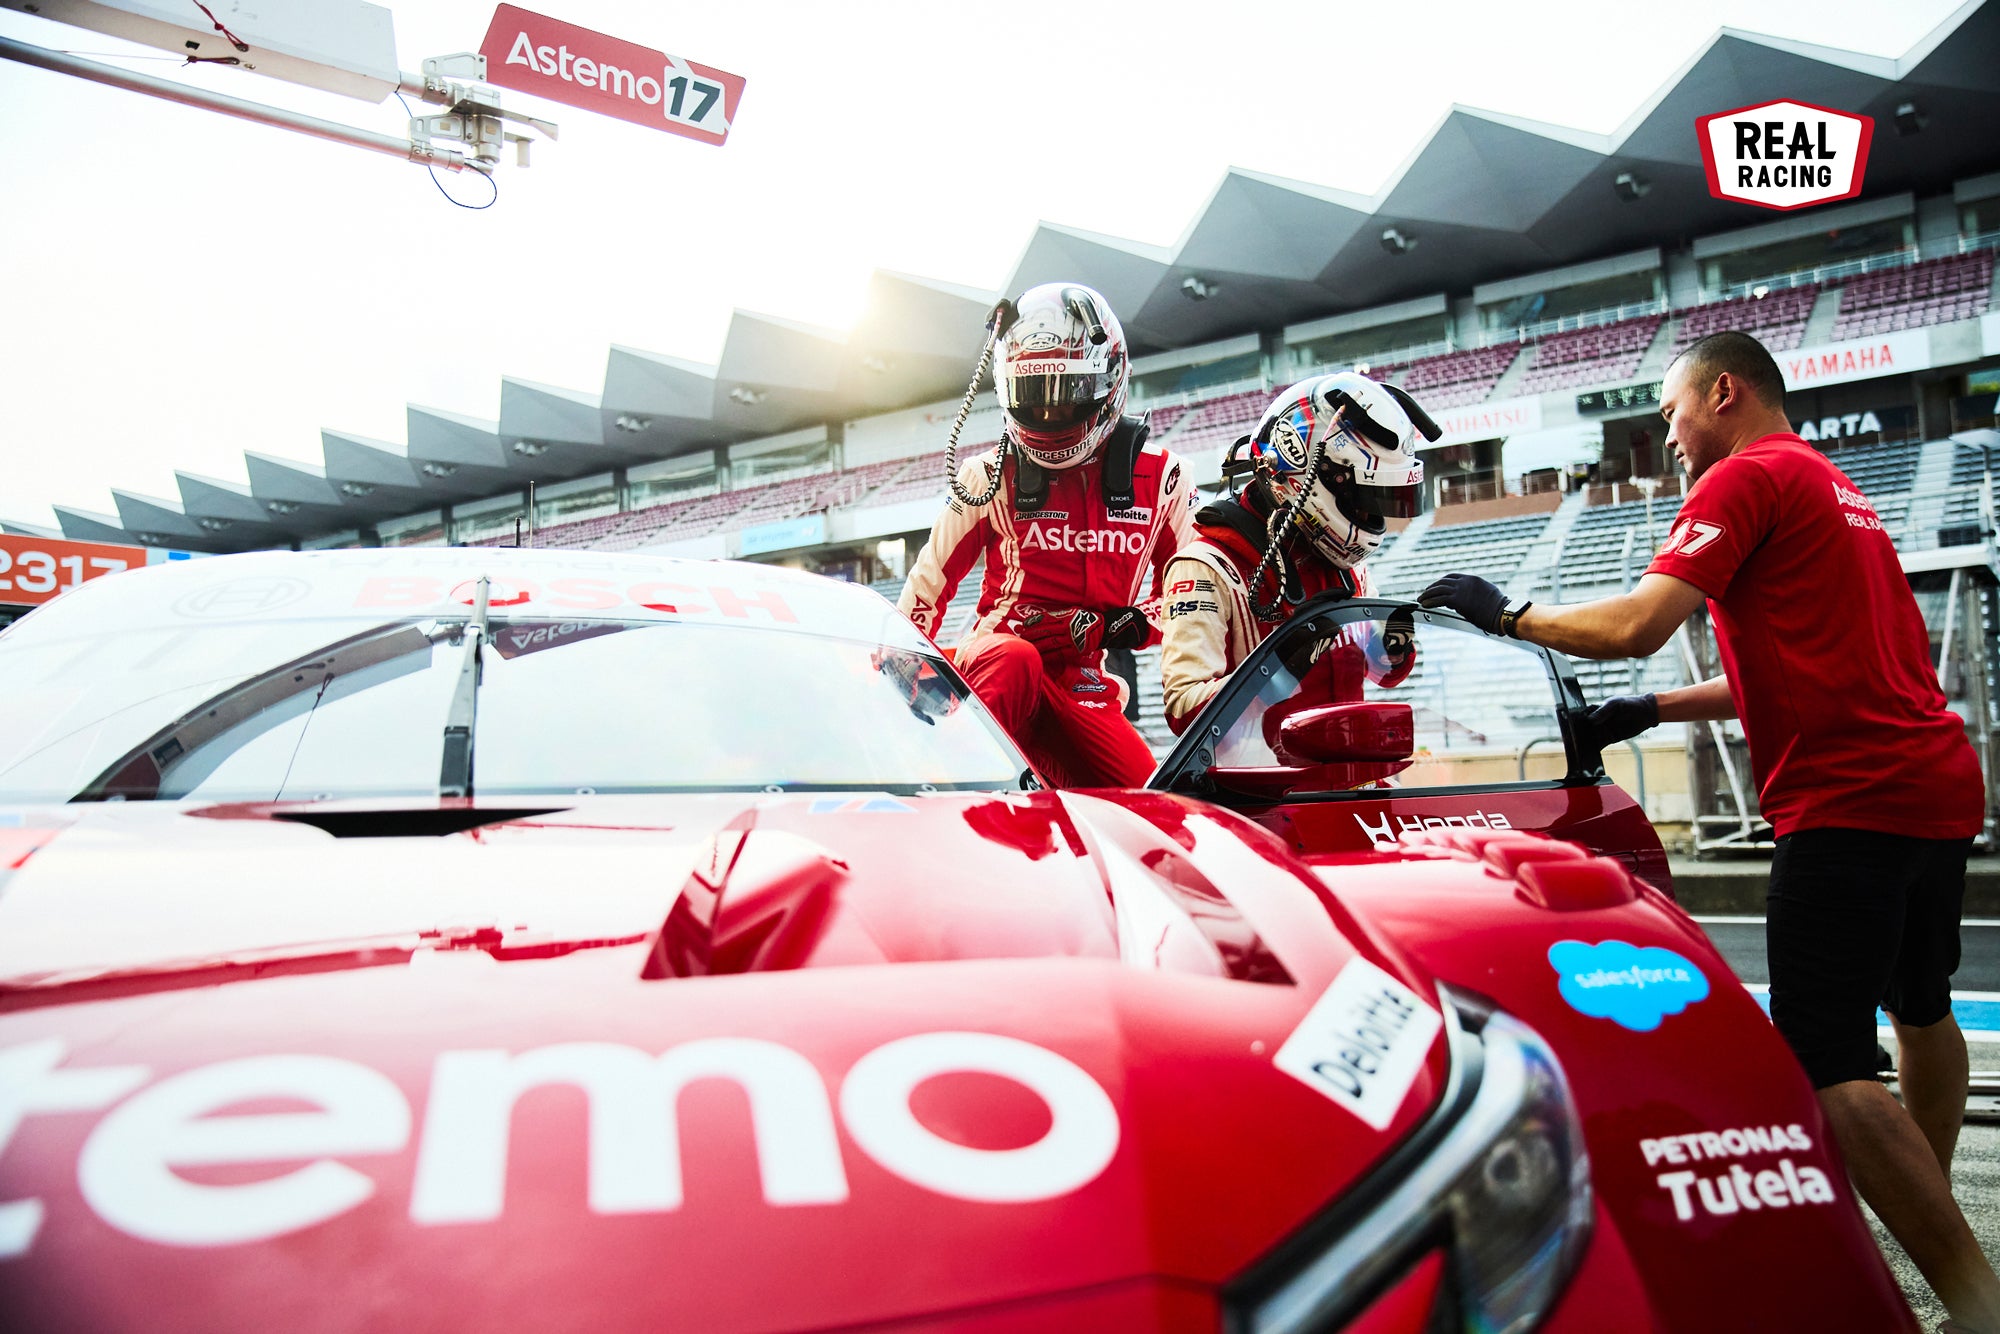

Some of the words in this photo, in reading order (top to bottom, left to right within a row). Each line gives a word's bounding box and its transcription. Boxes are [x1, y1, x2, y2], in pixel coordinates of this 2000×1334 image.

[505, 31, 662, 105] Astemo
[669, 75, 721, 123] 17
[1015, 361, 1067, 375] Astemo
[1789, 344, 1894, 381] YAMAHA
[1443, 405, 1530, 436] AIHATSU
[1799, 410, 1882, 441] ARTA
[1276, 426, 1307, 463] Arai
[1015, 511, 1069, 521] BRIDGESTONE
[1020, 521, 1146, 556] Astemo
[1662, 518, 1725, 556] 17
[352, 574, 800, 623] BOSCH
[1396, 809, 1513, 833] Honda
[1574, 964, 1691, 990] salesforce
[1639, 1123, 1812, 1167] PETRONAS
[1656, 1158, 1837, 1222] Tutela
